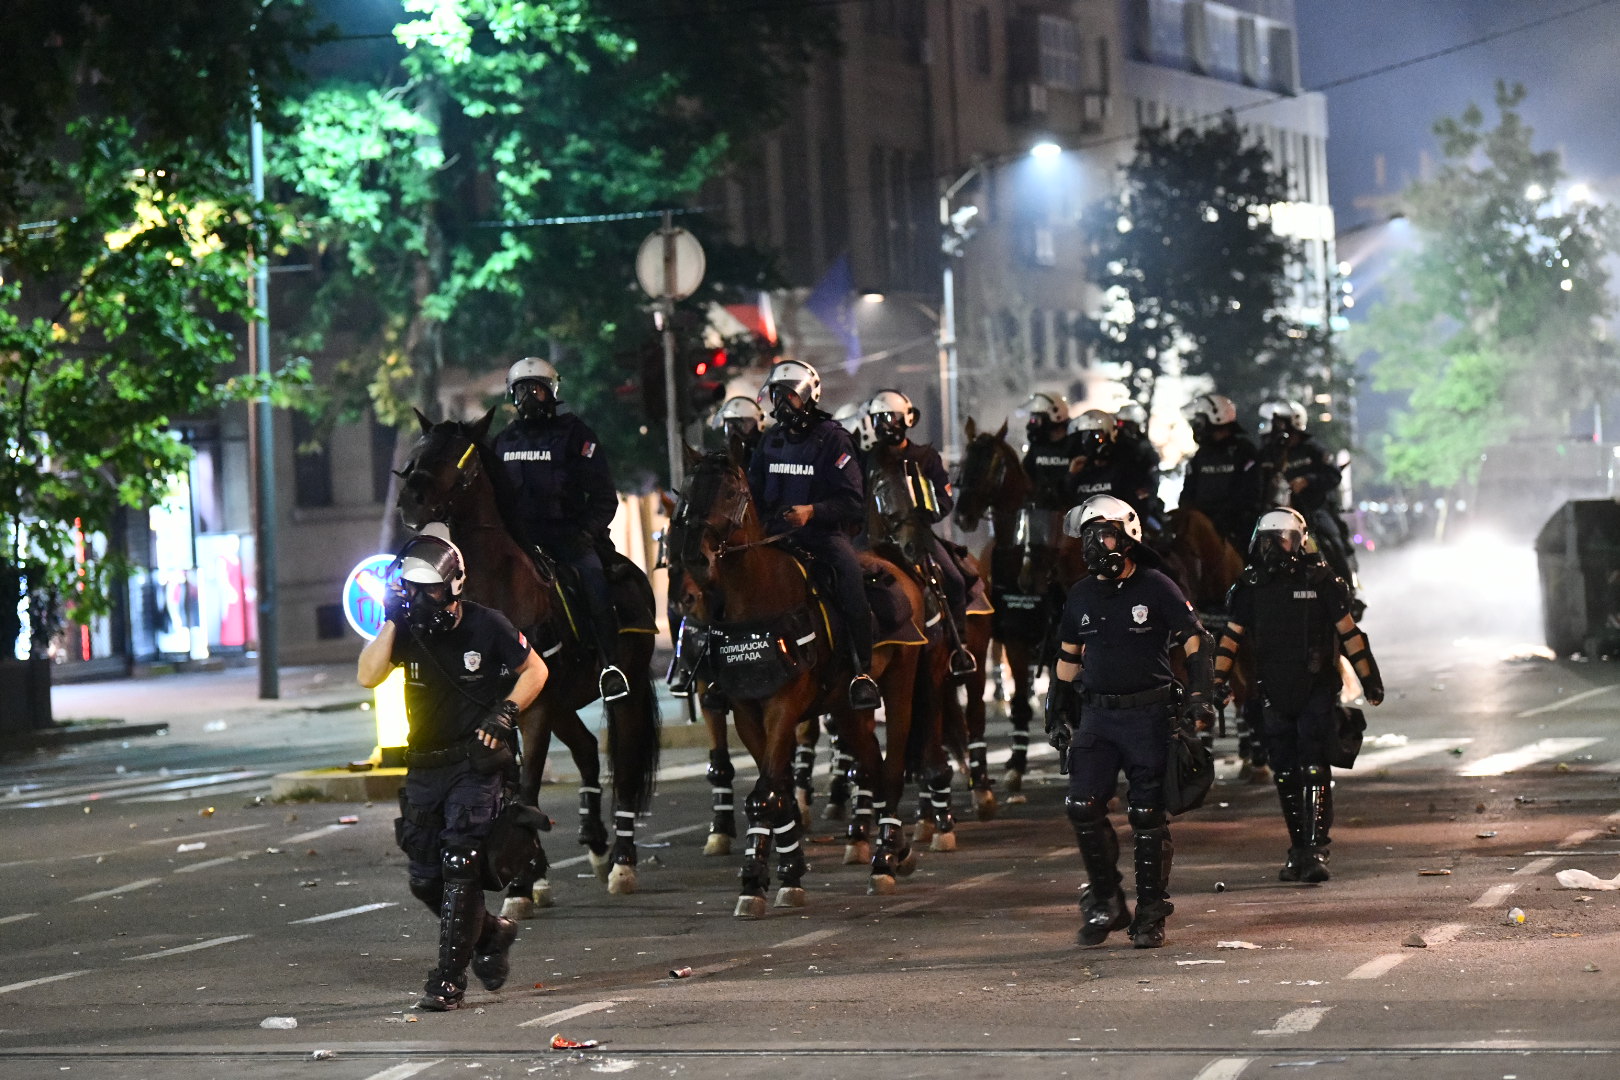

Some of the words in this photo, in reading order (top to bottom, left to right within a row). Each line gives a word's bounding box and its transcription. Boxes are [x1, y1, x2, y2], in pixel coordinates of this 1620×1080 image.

[503, 450, 552, 462] ПОЛИЦИЈА
[768, 463, 814, 476] ПОЛИЦИЈА
[719, 640, 770, 655] ПОЛИЦИЈСКА
[726, 651, 762, 664] БРИГАДА
